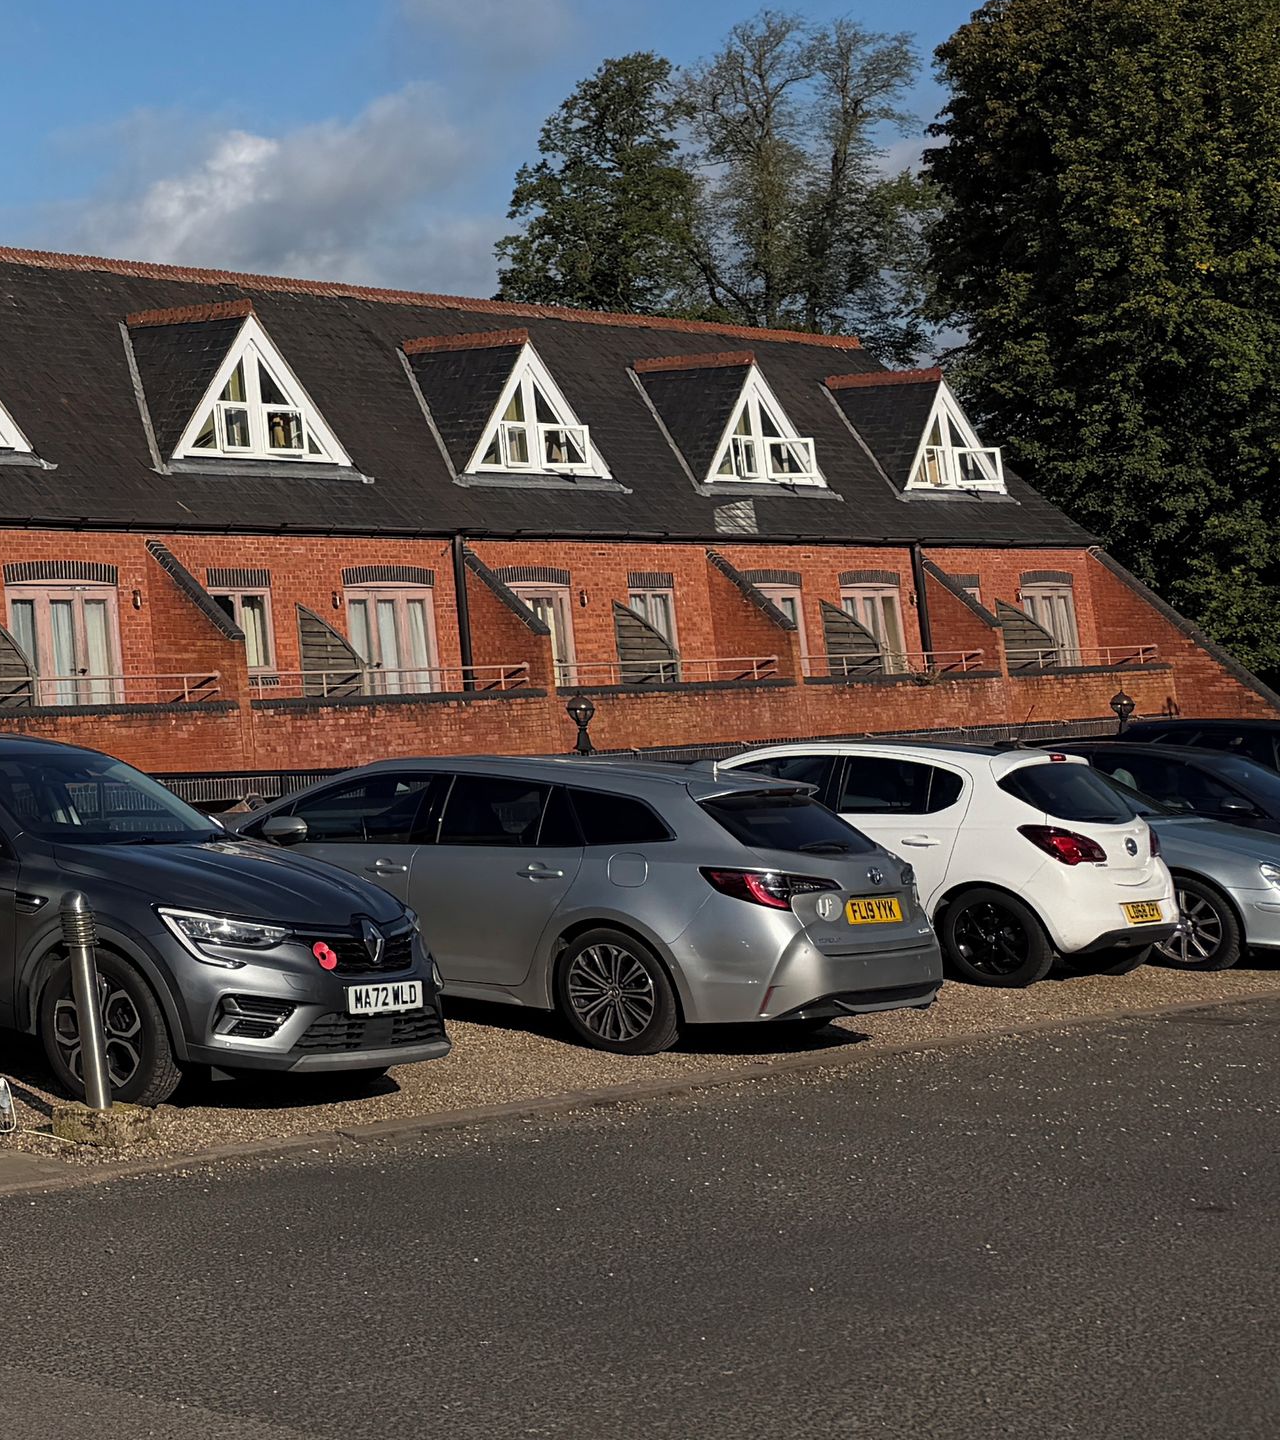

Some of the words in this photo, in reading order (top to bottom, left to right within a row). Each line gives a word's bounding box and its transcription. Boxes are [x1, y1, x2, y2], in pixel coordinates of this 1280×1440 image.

[850, 902, 876, 921] FL19
[875, 899, 897, 920] YYK
[354, 986, 389, 1009] MA72
[392, 984, 417, 1006] WLD
